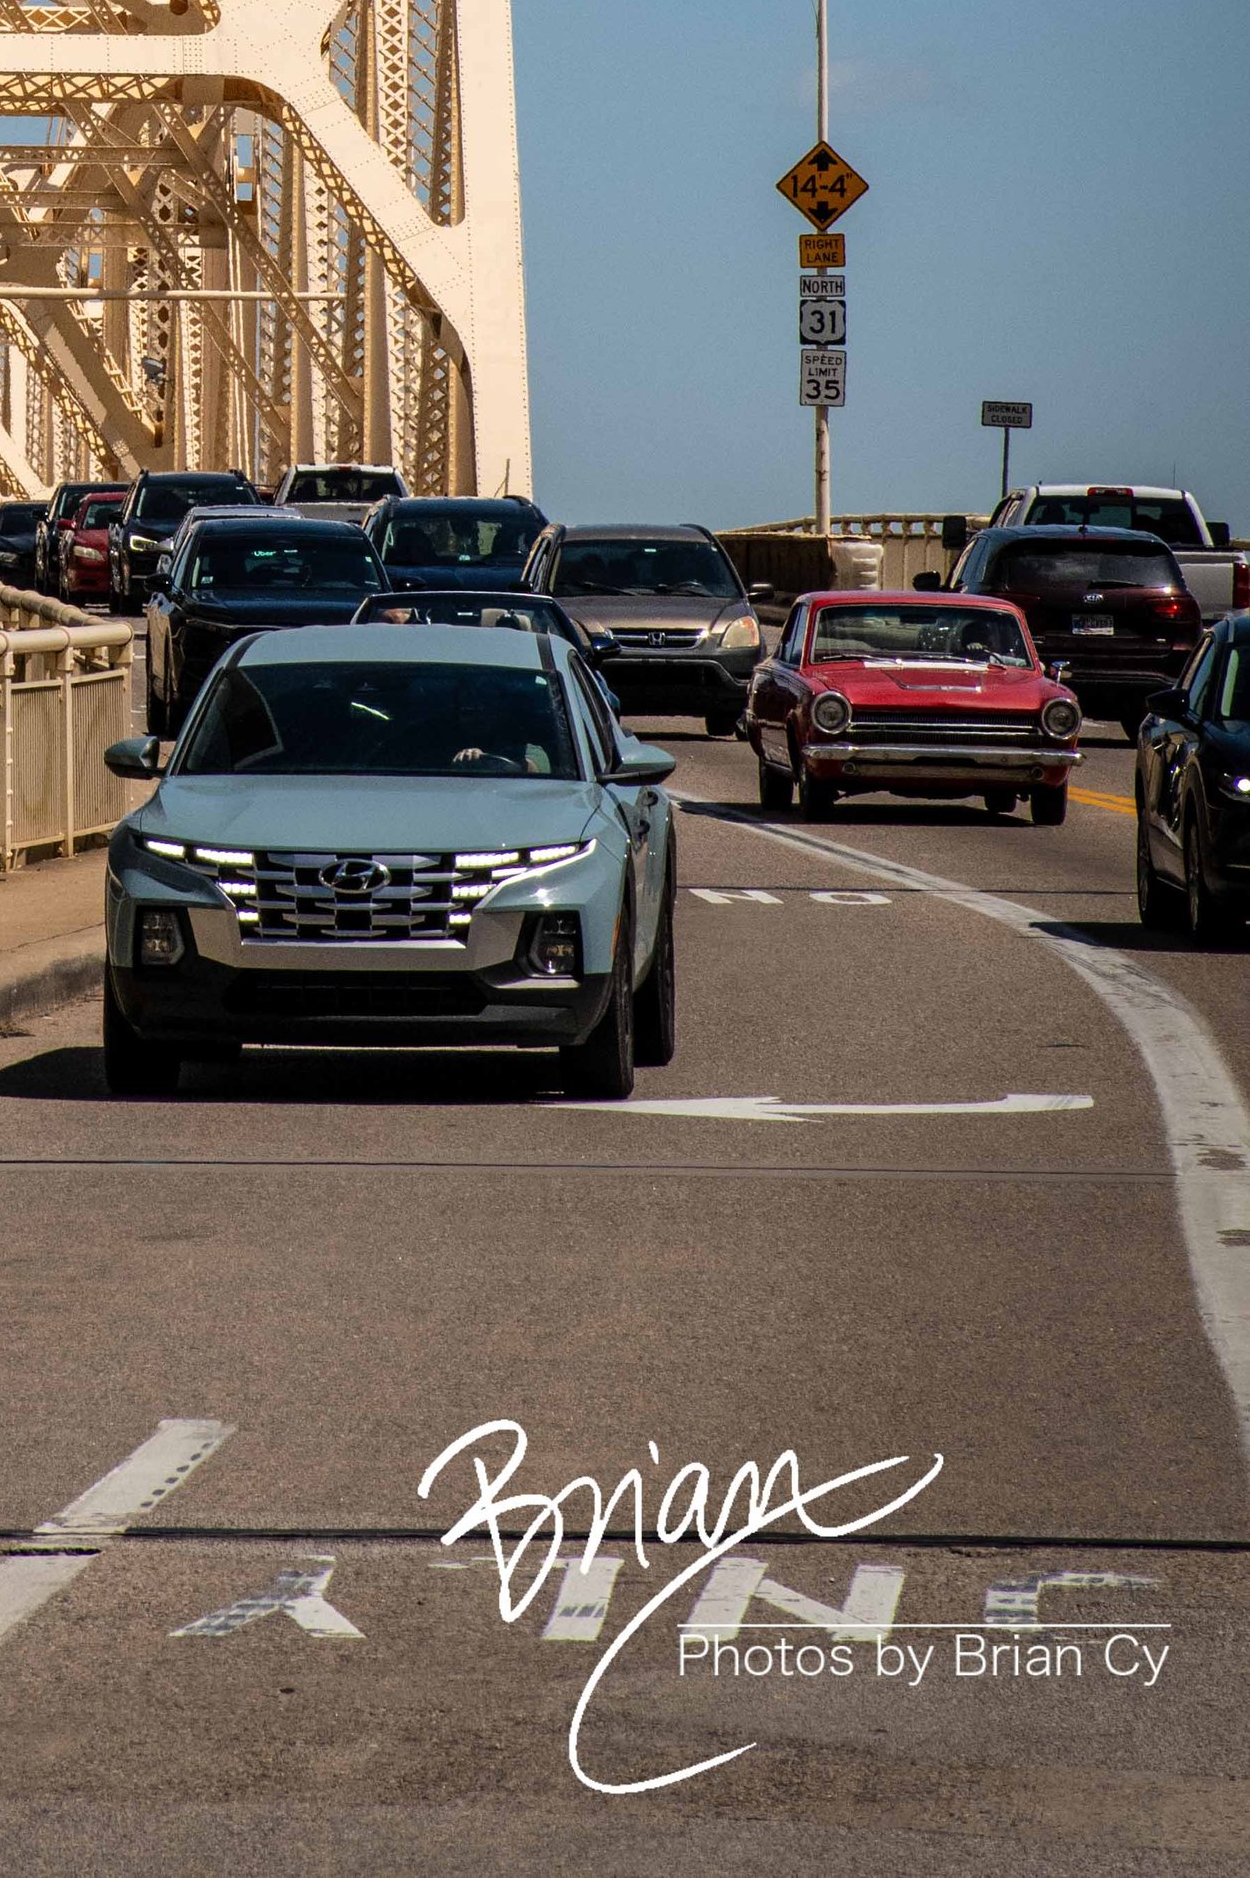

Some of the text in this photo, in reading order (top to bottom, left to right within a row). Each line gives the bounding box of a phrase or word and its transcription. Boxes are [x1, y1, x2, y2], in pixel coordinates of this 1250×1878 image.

[804, 238, 841, 250] RIGHT
[806, 251, 839, 263] LANE
[802, 279, 843, 294] NORTH
[809, 309, 837, 335] 31
[804, 355, 843, 366] SPEED
[807, 367, 839, 378] LIMIT
[805, 379, 841, 400] 35
[986, 404, 1029, 415] SIDEWALK
[990, 415, 1023, 424] CLOSED
